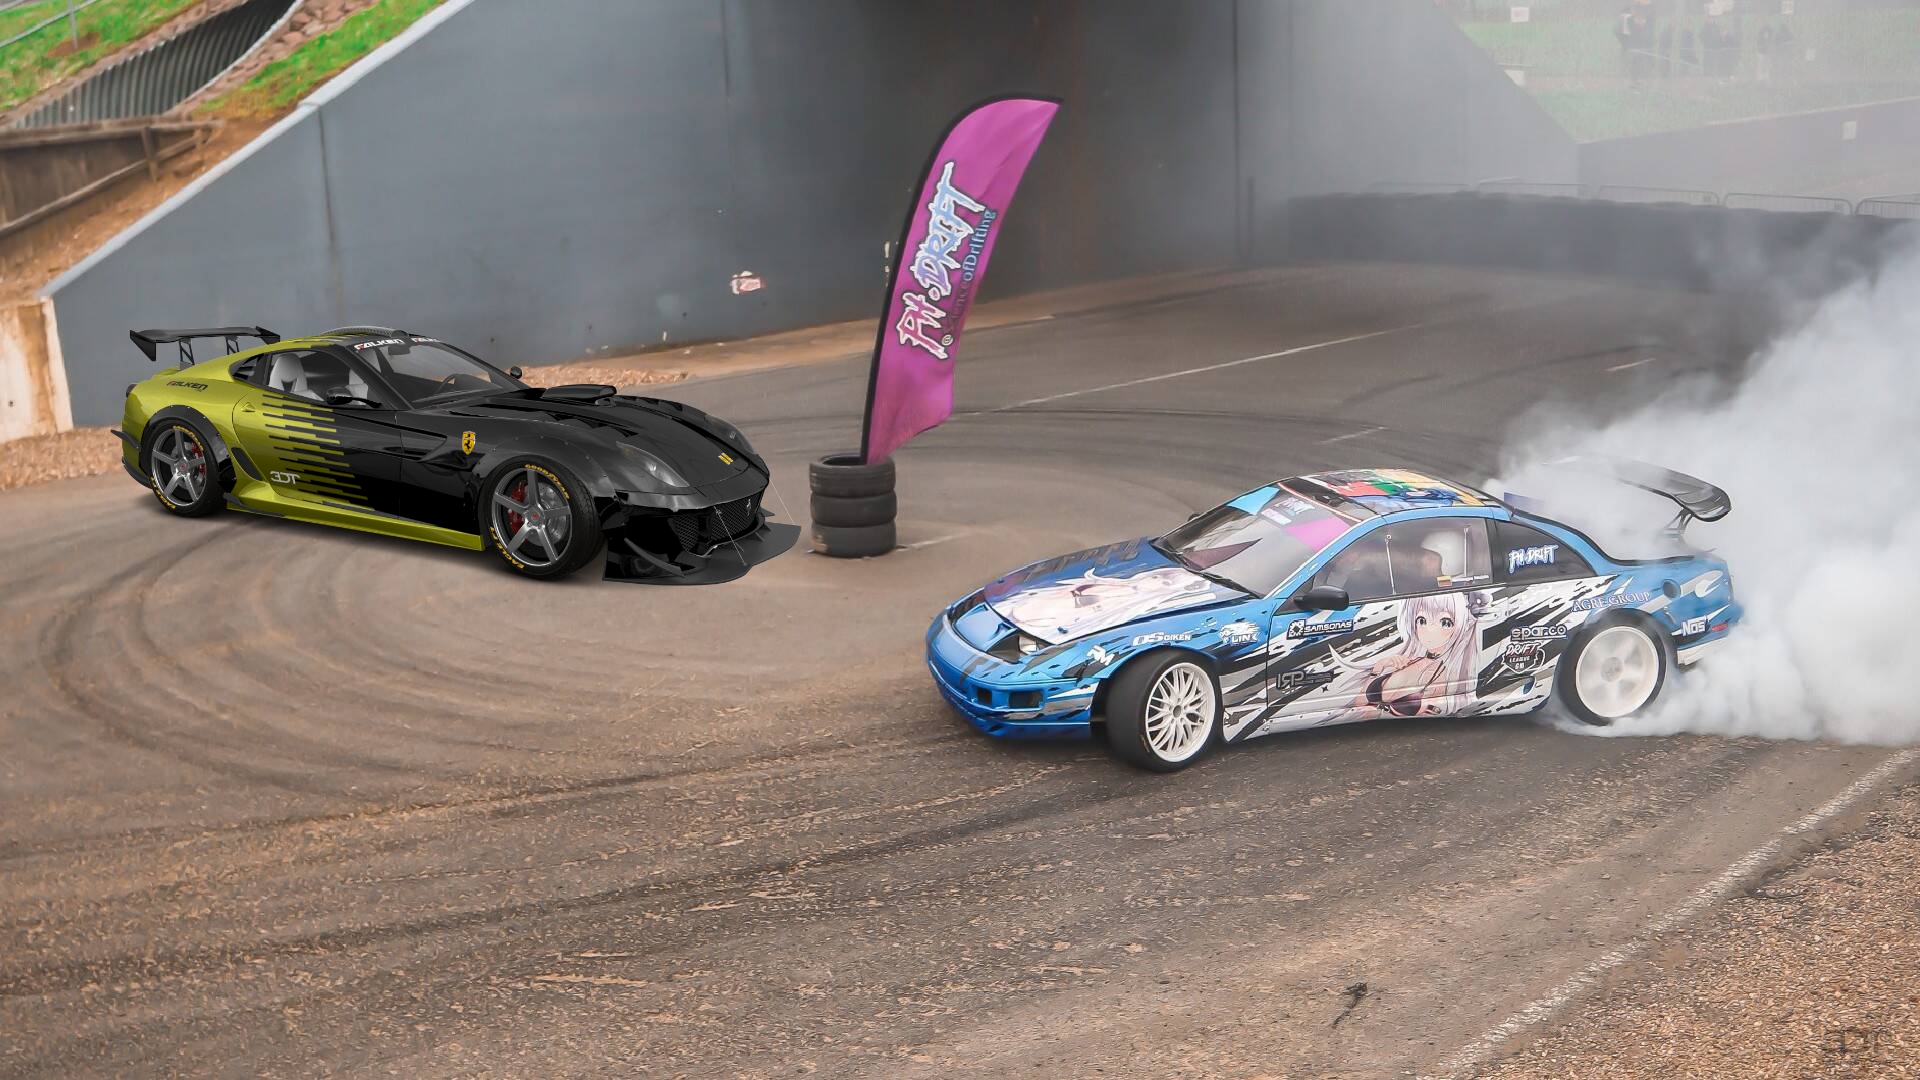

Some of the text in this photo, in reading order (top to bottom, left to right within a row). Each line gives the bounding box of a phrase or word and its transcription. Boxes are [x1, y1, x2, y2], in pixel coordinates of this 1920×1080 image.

[354, 338, 405, 349] FALKEN
[167, 381, 208, 391] FALKEN
[525, 464, 570, 499] GOODYEAR
[497, 542, 525, 569] EAGLE
[1304, 622, 1352, 633] SAMSONAS
[1505, 643, 1539, 656] DRIFT
